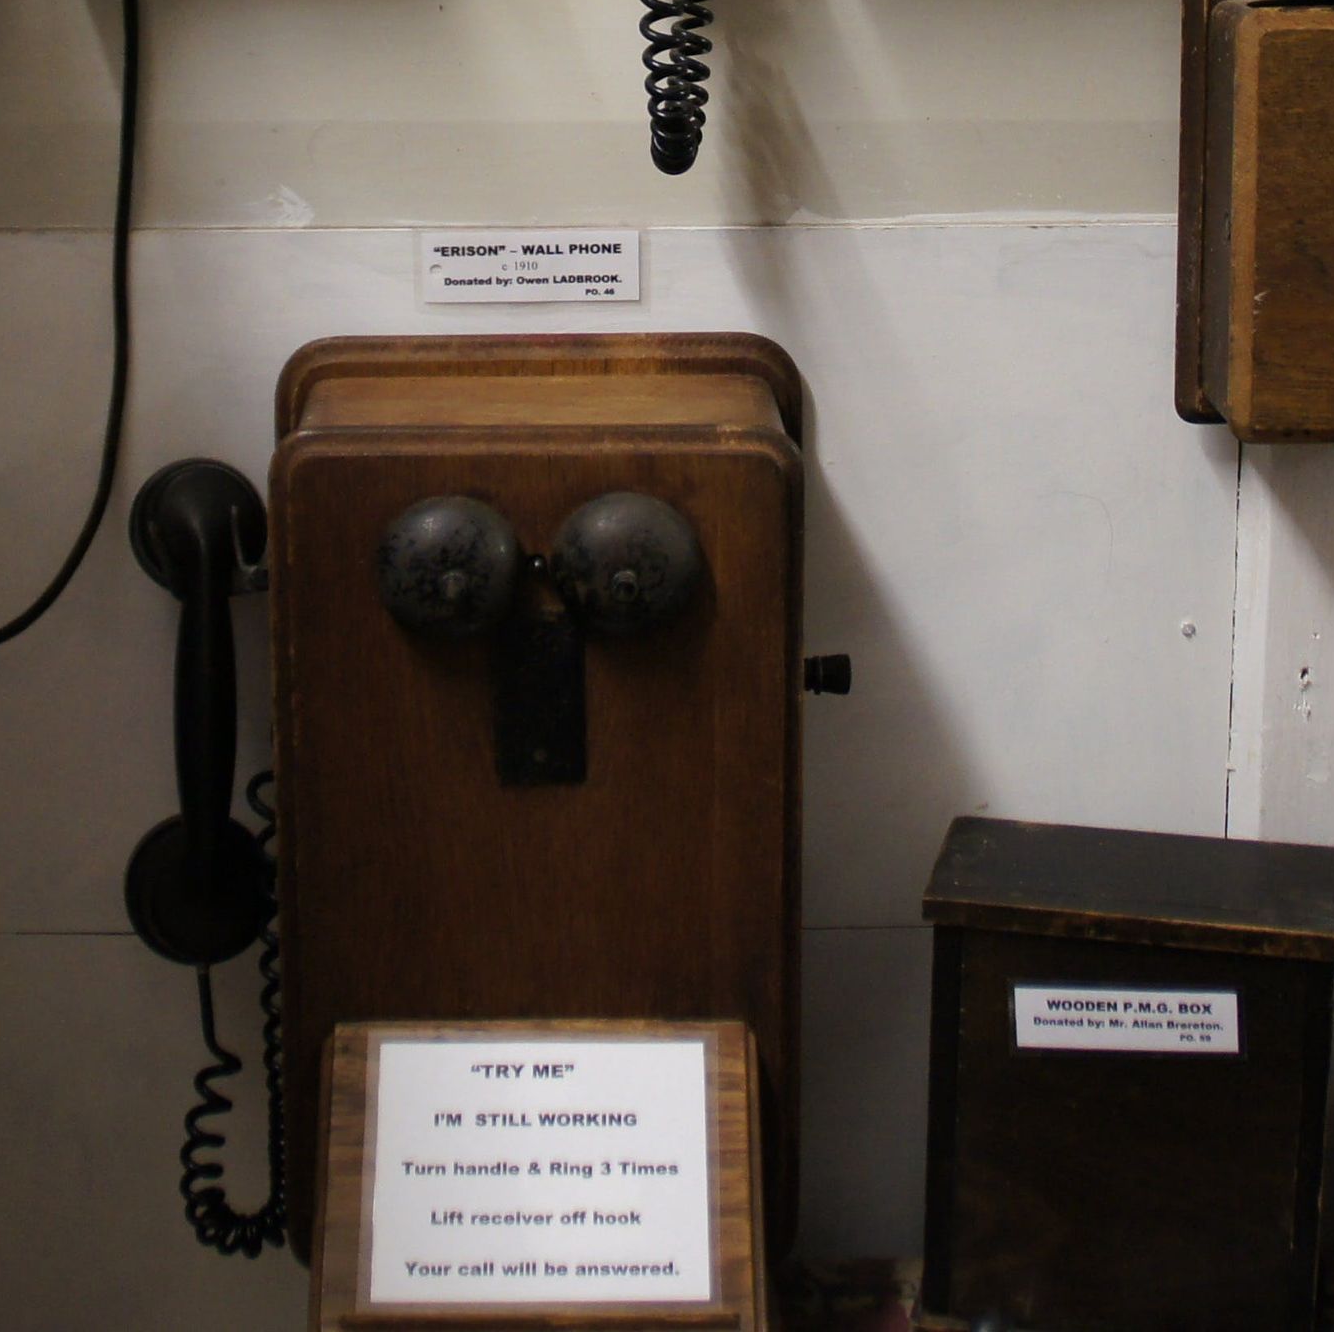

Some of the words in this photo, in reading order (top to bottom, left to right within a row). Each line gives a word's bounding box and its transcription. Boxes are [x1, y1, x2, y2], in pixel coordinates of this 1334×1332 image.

[522, 245, 563, 255] WALL
[569, 243, 622, 254] PHONE
[514, 261, 537, 270] 1910
[444, 277, 492, 286] Donated
[496, 277, 512, 287] by:
[517, 276, 549, 284] Owen
[553, 275, 622, 284] LADBROOK.
[1046, 999, 1118, 1013] WOODEN
[1124, 1003, 1172, 1014] P.M.G.
[1179, 1003, 1212, 1014] BOX
[476, 1114, 532, 1126] STILL
[538, 1114, 637, 1126] WORKING
[402, 1162, 446, 1176] Turn
[453, 1162, 519, 1176] handle
[528, 1162, 541, 1175] &
[549, 1162, 593, 1178] Ring
[601, 1162, 611, 1175] 3
[617, 1162, 679, 1176] Times
[430, 1212, 463, 1225] Lift
[470, 1212, 553, 1225] receiver
[560, 1211, 586, 1225] off
[593, 1212, 641, 1225] hook
[405, 1262, 451, 1276] Your
[457, 1262, 494, 1276] call
[502, 1262, 537, 1276] will
[544, 1262, 568, 1276] be
[575, 1262, 679, 1276] answered.
